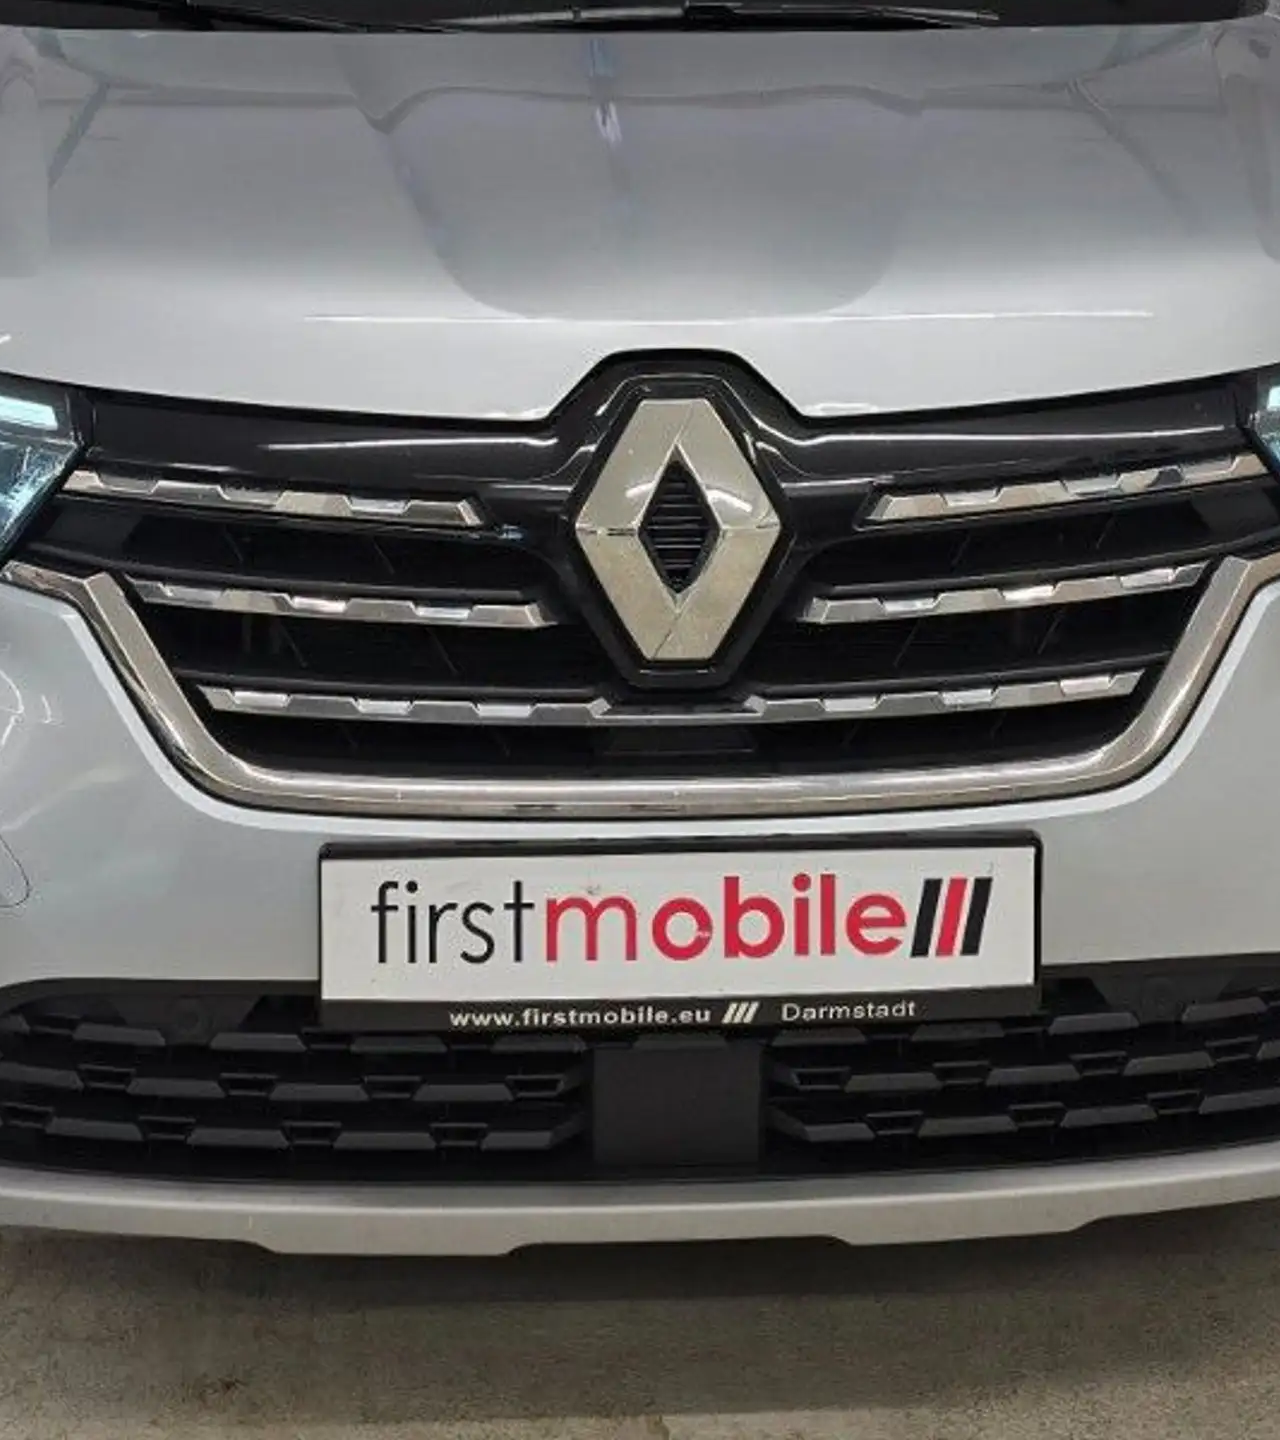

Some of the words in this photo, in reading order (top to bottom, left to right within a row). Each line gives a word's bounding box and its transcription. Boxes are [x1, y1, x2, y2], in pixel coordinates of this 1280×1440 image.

[370, 874, 907, 965] firstmobile
[449, 1004, 712, 1029] www.firstmobile.eu
[781, 999, 916, 1022] Darmstadt
